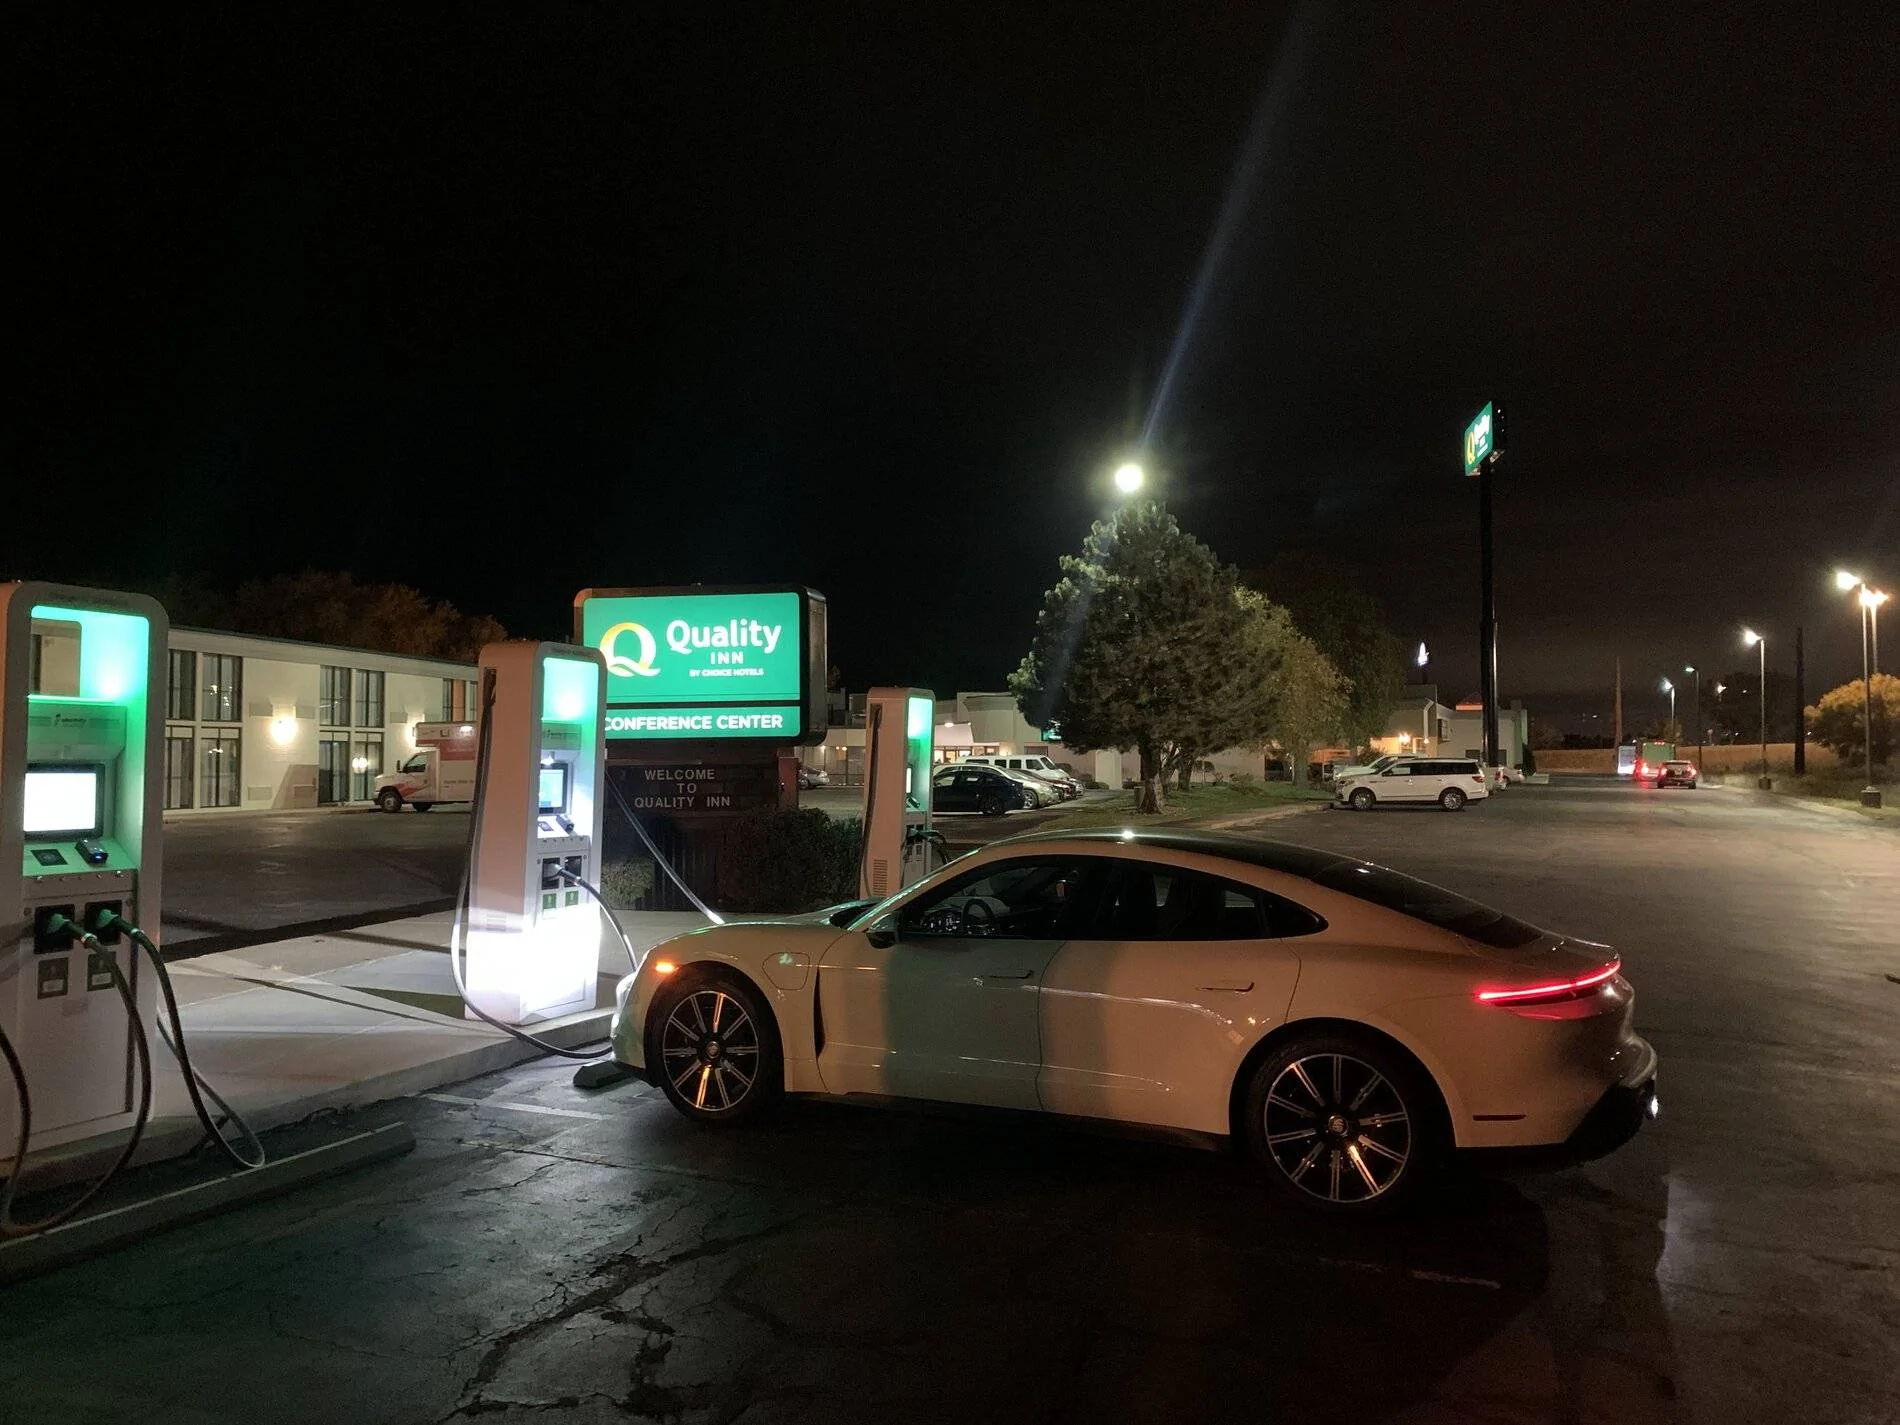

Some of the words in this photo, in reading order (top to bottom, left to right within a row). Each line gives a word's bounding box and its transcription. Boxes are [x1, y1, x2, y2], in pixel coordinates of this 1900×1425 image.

[666, 618, 782, 655] Quality
[710, 651, 744, 665] INN
[716, 714, 783, 730] CENTER
[644, 769, 716, 781] WELCOME
[676, 783, 698, 794] TO
[634, 796, 695, 809] QUALITY
[706, 796, 731, 808] INN
